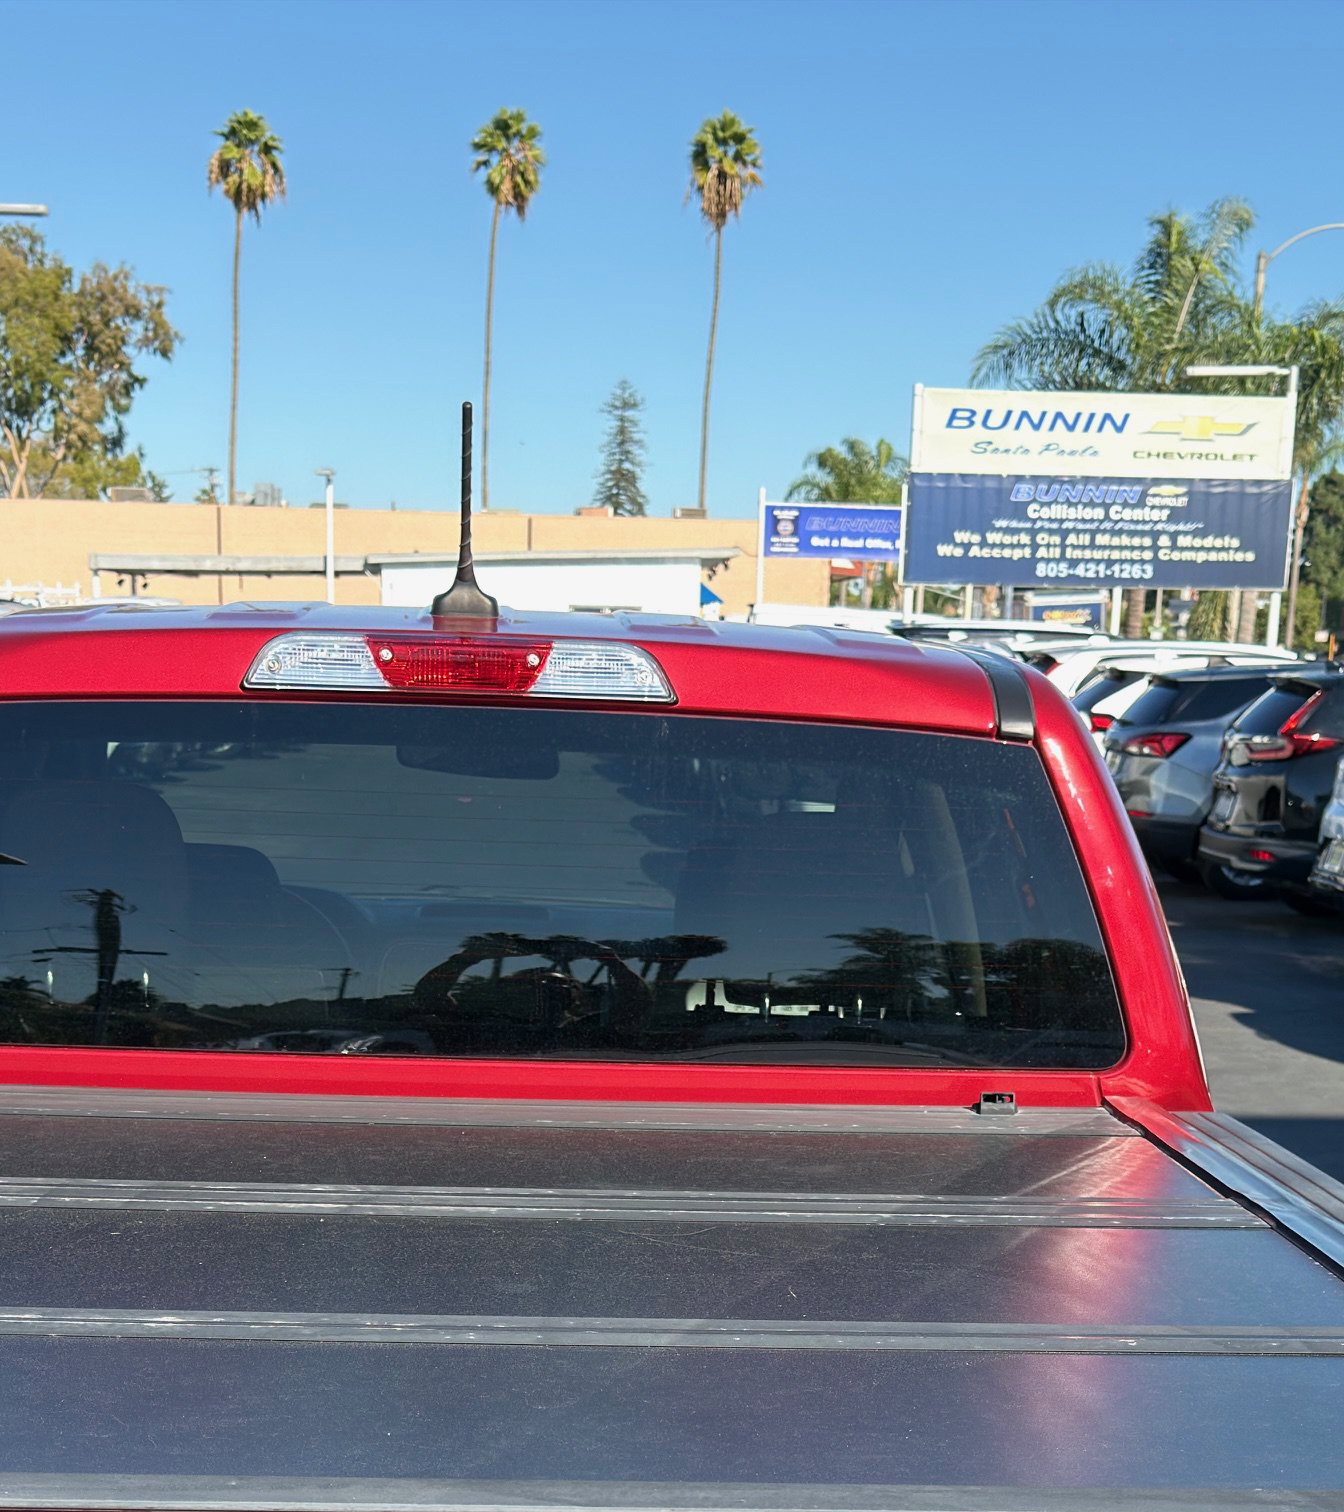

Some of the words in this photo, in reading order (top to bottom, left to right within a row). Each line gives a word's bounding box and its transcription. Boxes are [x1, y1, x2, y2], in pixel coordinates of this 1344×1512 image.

[945, 407, 1130, 434] BUNNIN
[971, 441, 1031, 455] Santa
[1132, 450, 1258, 462] CHEVROLET
[1010, 483, 1142, 503] BUNNIN
[1027, 503, 1105, 519] Collision
[1109, 505, 1171, 521] Center
[954, 531, 981, 544] We
[986, 532, 1031, 545] Work
[1036, 533, 1061, 545] On
[1065, 534, 1090, 546] All
[1095, 535, 1153, 547] Makes
[1157, 535, 1172, 547] &
[1177, 536, 1240, 549] Models
[937, 544, 964, 557] We
[968, 545, 1032, 560] Accept
[1035, 546, 1061, 558] All
[1066, 547, 1154, 560] Insurance
[1158, 549, 1255, 564] Companies
[1036, 561, 1153, 579] 805-421-1263
